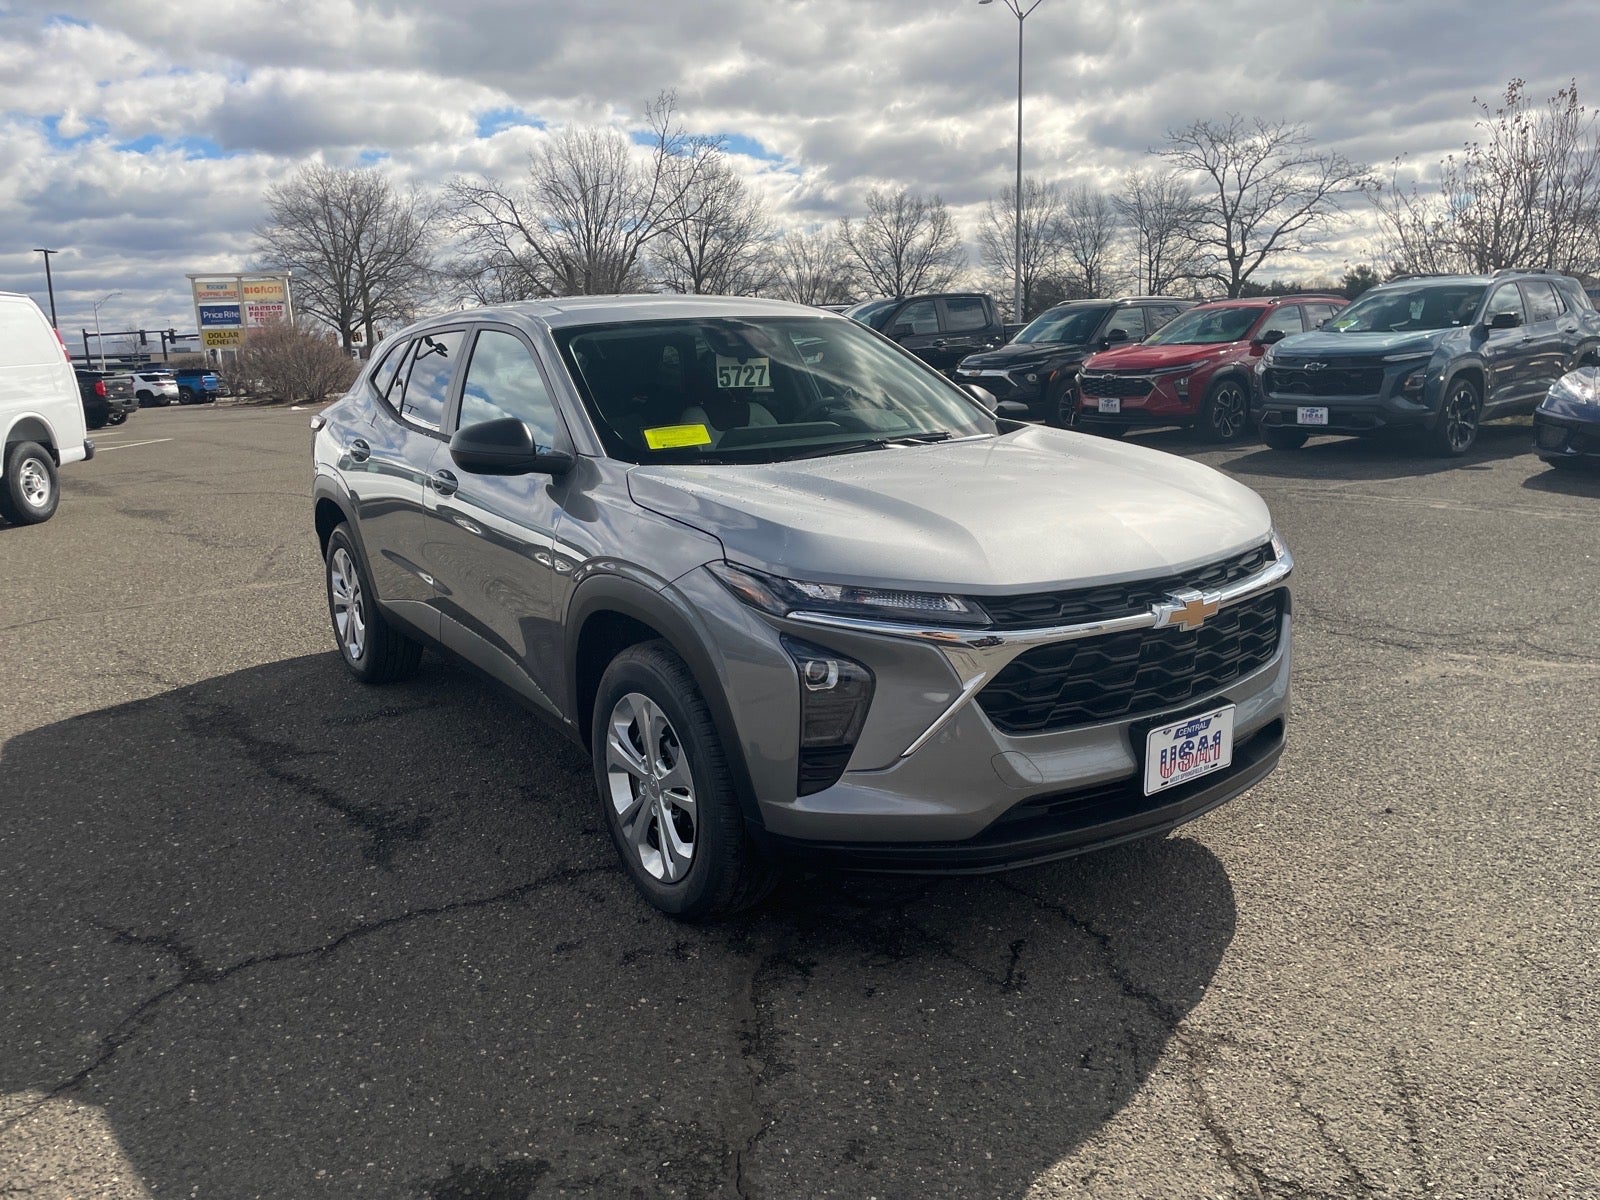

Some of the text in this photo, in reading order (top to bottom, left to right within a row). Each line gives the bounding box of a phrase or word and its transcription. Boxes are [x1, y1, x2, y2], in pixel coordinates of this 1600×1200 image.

[203, 311, 223, 319] Price
[718, 365, 766, 386] 5727
[1178, 722, 1208, 736] CENTRAL
